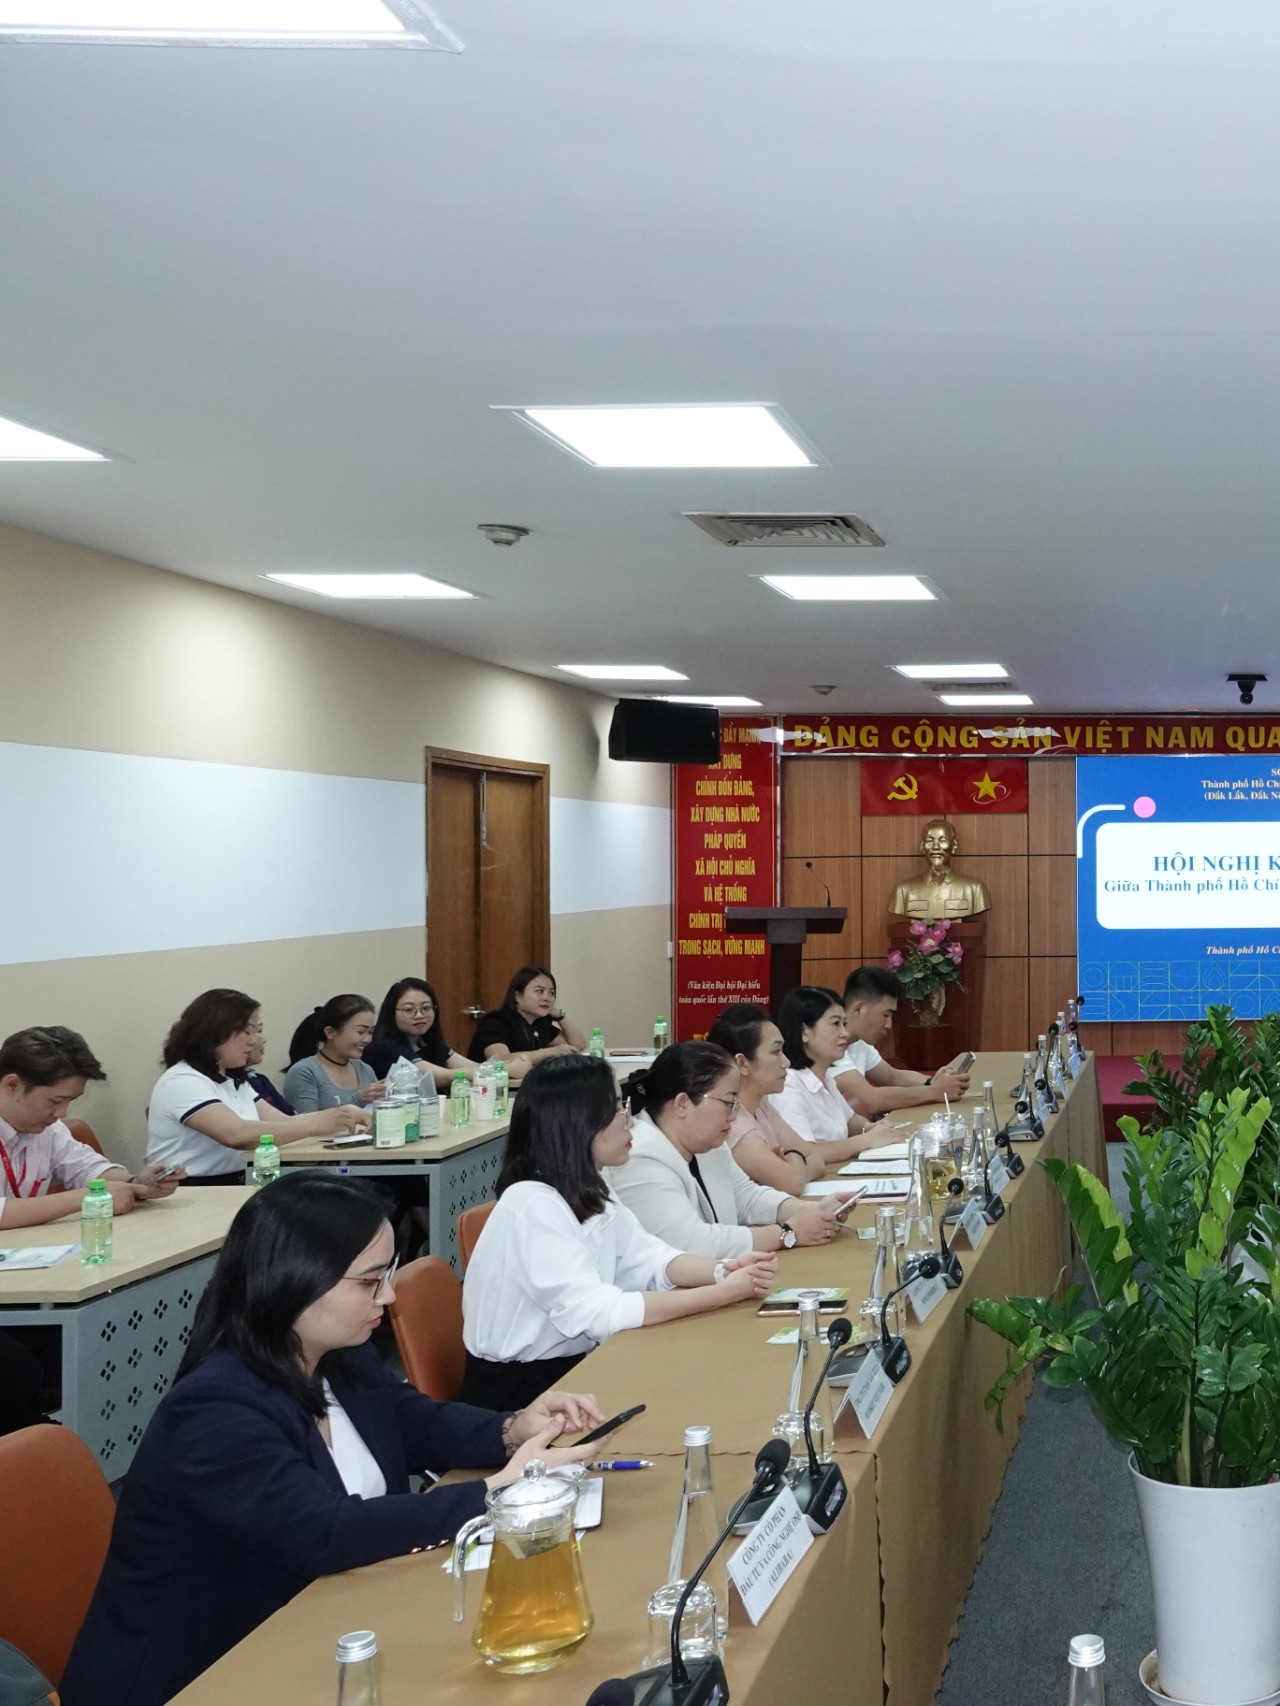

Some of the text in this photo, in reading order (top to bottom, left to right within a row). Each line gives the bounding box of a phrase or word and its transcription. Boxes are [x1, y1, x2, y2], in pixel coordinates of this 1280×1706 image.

[794, 716, 879, 748] ĐẢNG
[892, 719, 979, 752] CỘNG
[991, 717, 1053, 748] SẢN
[1063, 720, 1134, 752] VIỆT
[1146, 726, 1214, 748] NAM
[723, 753, 742, 774] DỰNG
[696, 774, 755, 797] CHỈNH ĐỐN ĐẢNG,
[1201, 780, 1230, 788] Thành
[1232, 778, 1249, 790] phố
[1251, 779, 1264, 788] Hồ
[1204, 790, 1225, 801] (Đắk
[1228, 790, 1248, 801] Lắk,
[1250, 790, 1269, 800] Đắk
[690, 803, 760, 826] XÂY DỰNG NHÀ NƯỚC
[704, 829, 747, 851] PHÁP QUYỀN
[695, 854, 756, 879] XÃ HỘI CHỦ NGHĨA
[1154, 851, 1194, 876] HỘI
[1202, 855, 1260, 875] NGHỊ
[704, 881, 747, 905] VÀ HỆ THỐNG
[1104, 880, 1140, 892] Giữa
[1145, 880, 1191, 891] Thành
[1197, 877, 1223, 894] phố
[1228, 877, 1249, 891] Hồ
[1253, 878, 1279, 891] Chí
[689, 909, 722, 932] CHÍNH TRỊ
[679, 935, 765, 959] TRONG SẠCH, VỮNG MẠNH
[1206, 945, 1235, 955] Thành
[1236, 945, 1254, 956] phố
[1256, 945, 1270, 954] Hồ
[742, 1505, 787, 1565] CÔNG TY CỔ PHẦN
[768, 1549, 794, 1588] (ALIBABA)
